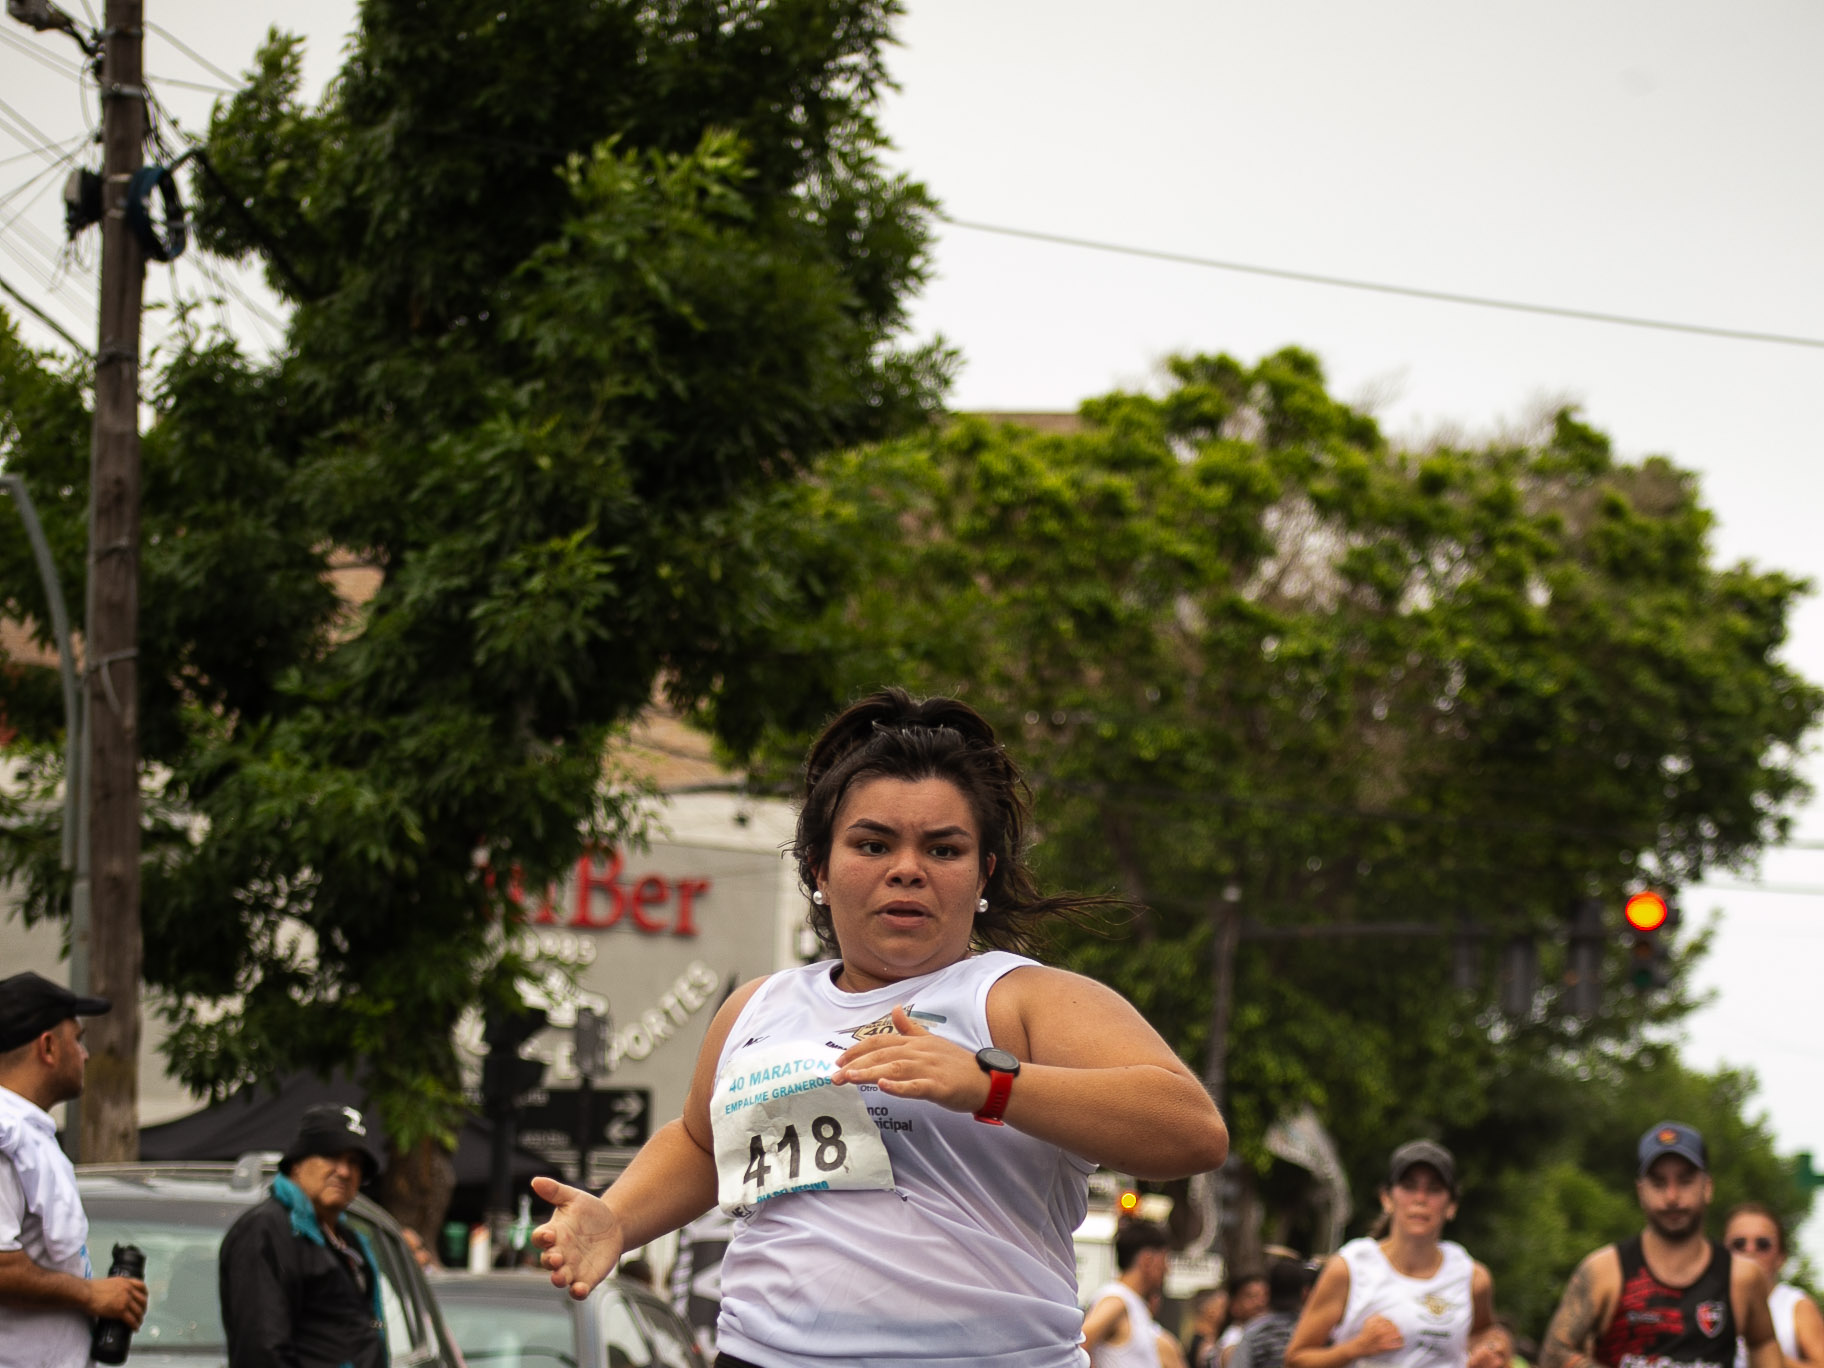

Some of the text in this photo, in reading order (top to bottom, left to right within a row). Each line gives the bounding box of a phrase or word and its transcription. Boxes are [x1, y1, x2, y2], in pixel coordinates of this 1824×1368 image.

[725, 1075, 833, 1115] EMPALME GRANEROS
[729, 1058, 832, 1094] 40 MARATON
[860, 1084, 878, 1092] Otro
[743, 1115, 848, 1189] 418
